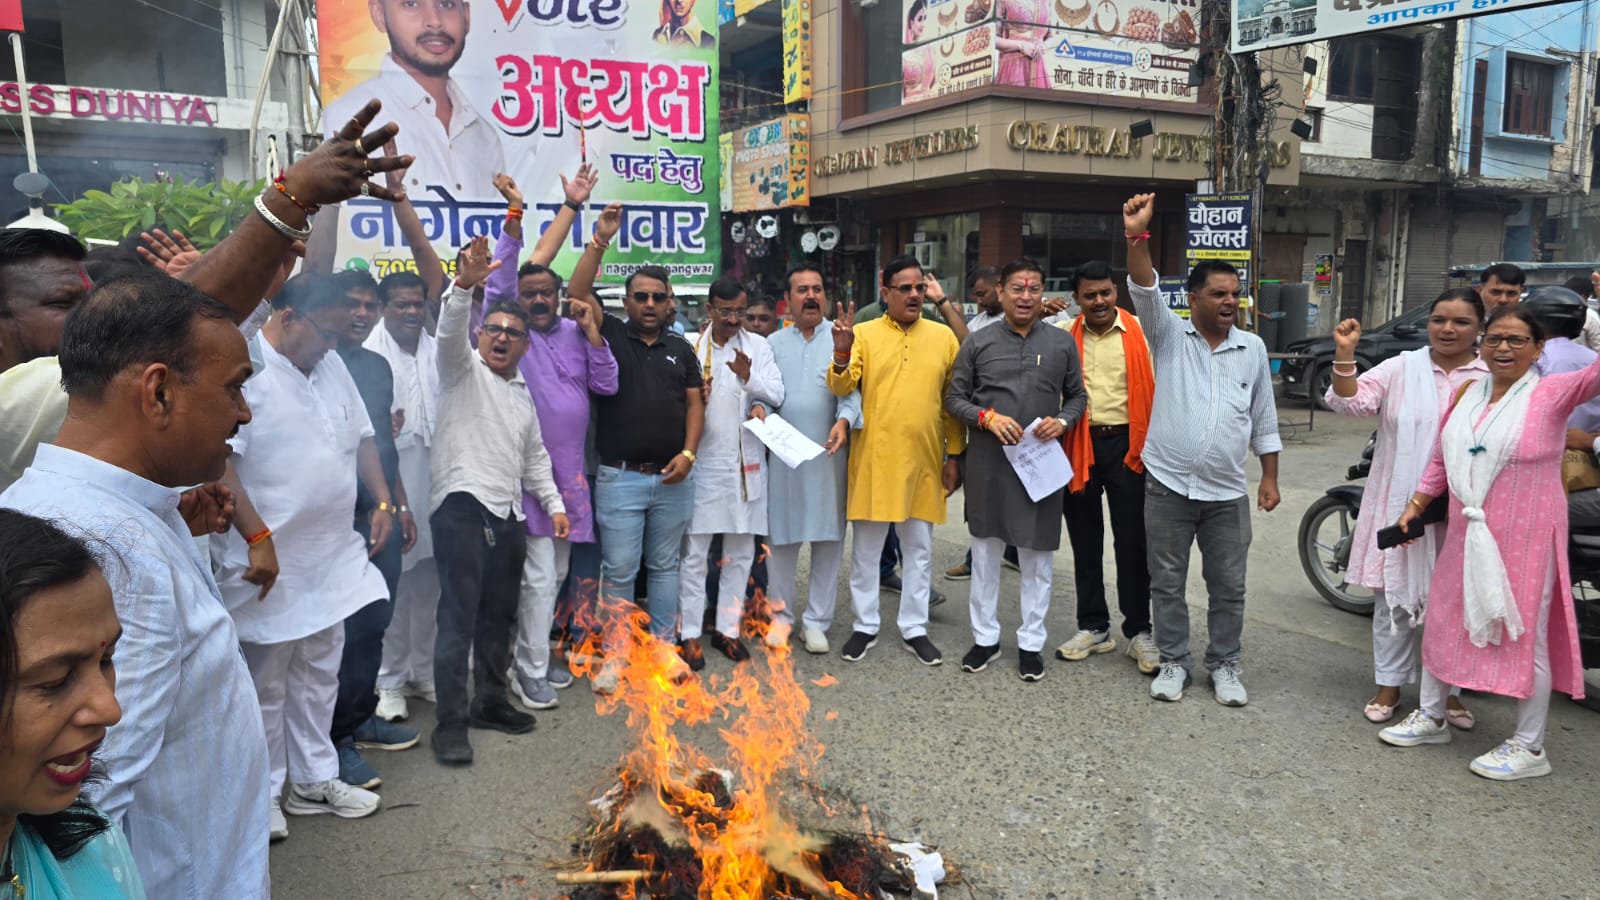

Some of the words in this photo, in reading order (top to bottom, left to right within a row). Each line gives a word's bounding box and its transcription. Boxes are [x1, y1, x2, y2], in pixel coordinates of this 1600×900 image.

[1367, 0, 1459, 24] आपका
[70, 87, 213, 127] DUNIYA
[491, 55, 706, 135] अध्यक्ष
[610, 154, 655, 180] पद
[658, 148, 702, 191] हेतु
[1189, 202, 1244, 226] चौहान
[1189, 225, 1249, 248] ज्वैलर्स
